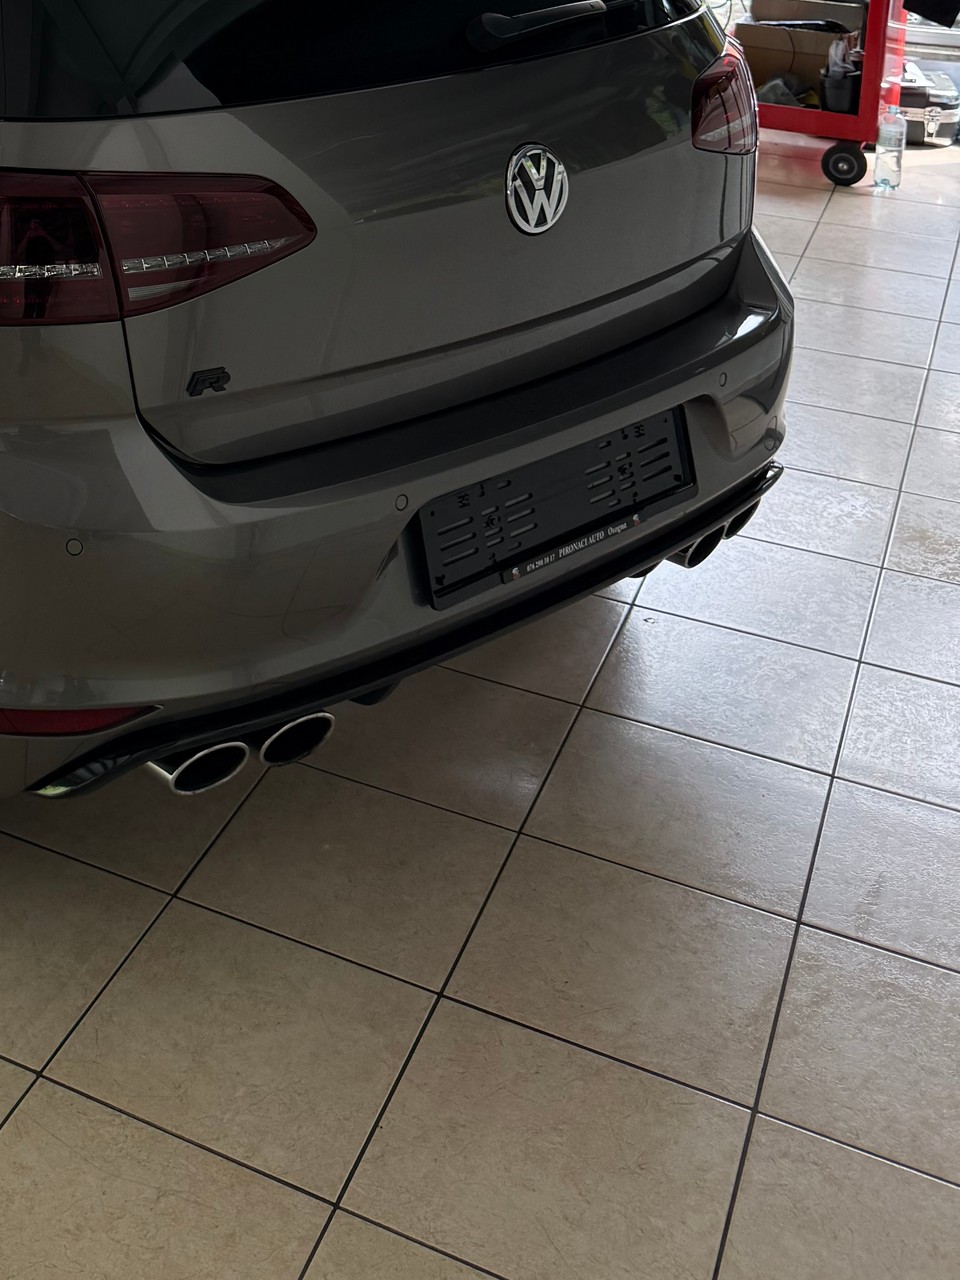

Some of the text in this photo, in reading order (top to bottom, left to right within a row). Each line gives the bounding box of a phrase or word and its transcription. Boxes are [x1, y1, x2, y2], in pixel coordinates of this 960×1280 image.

[186, 366, 231, 397] R
[558, 538, 588, 558] PIRONACI
[588, 530, 605, 545] AUTO
